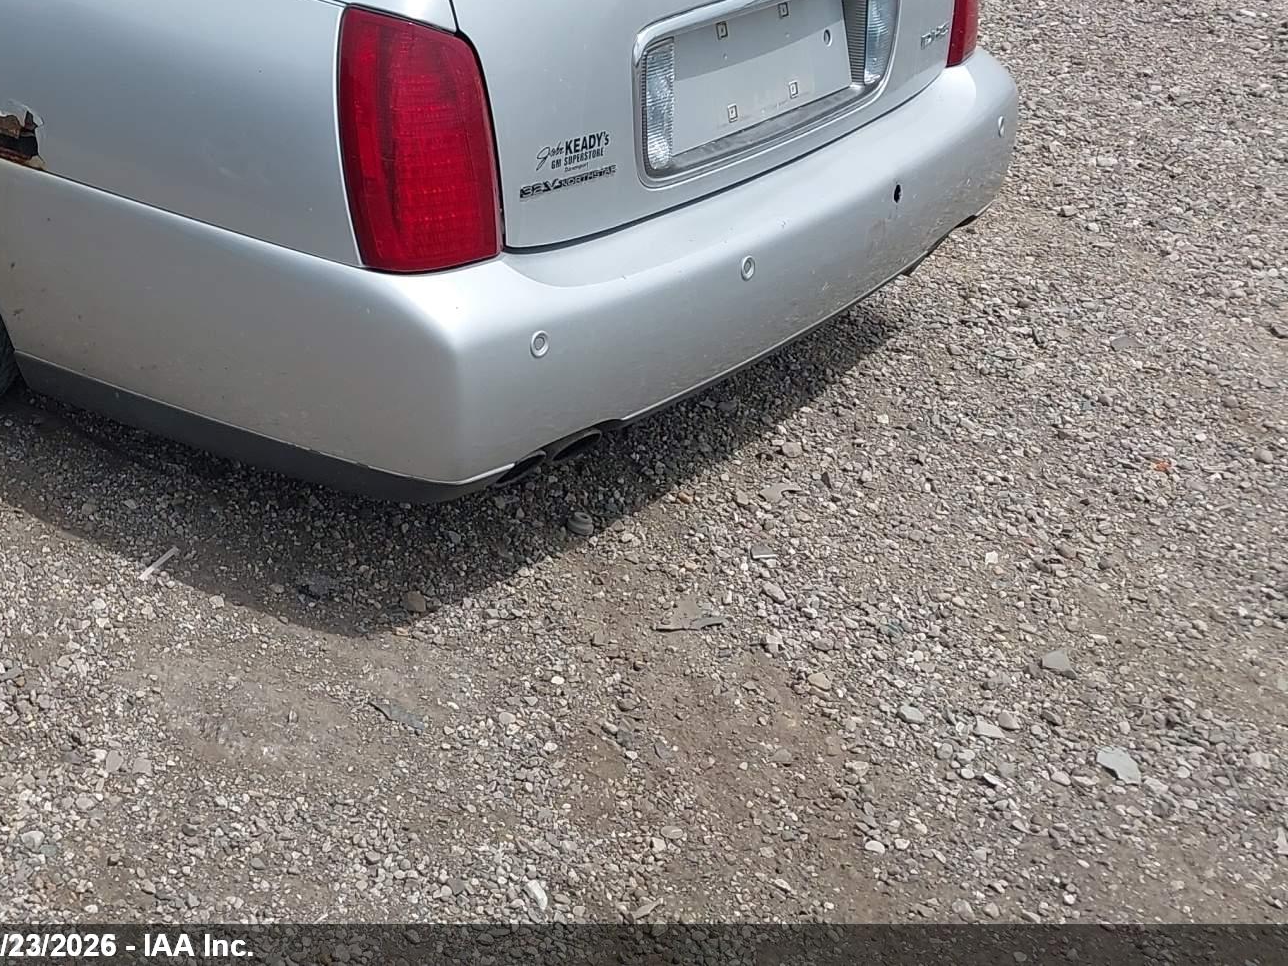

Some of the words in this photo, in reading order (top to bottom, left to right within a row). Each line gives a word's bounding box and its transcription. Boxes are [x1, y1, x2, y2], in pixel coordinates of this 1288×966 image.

[565, 131, 610, 155] KEADY's
[551, 158, 562, 170] GM
[564, 147, 604, 166] SUPERSTORE
